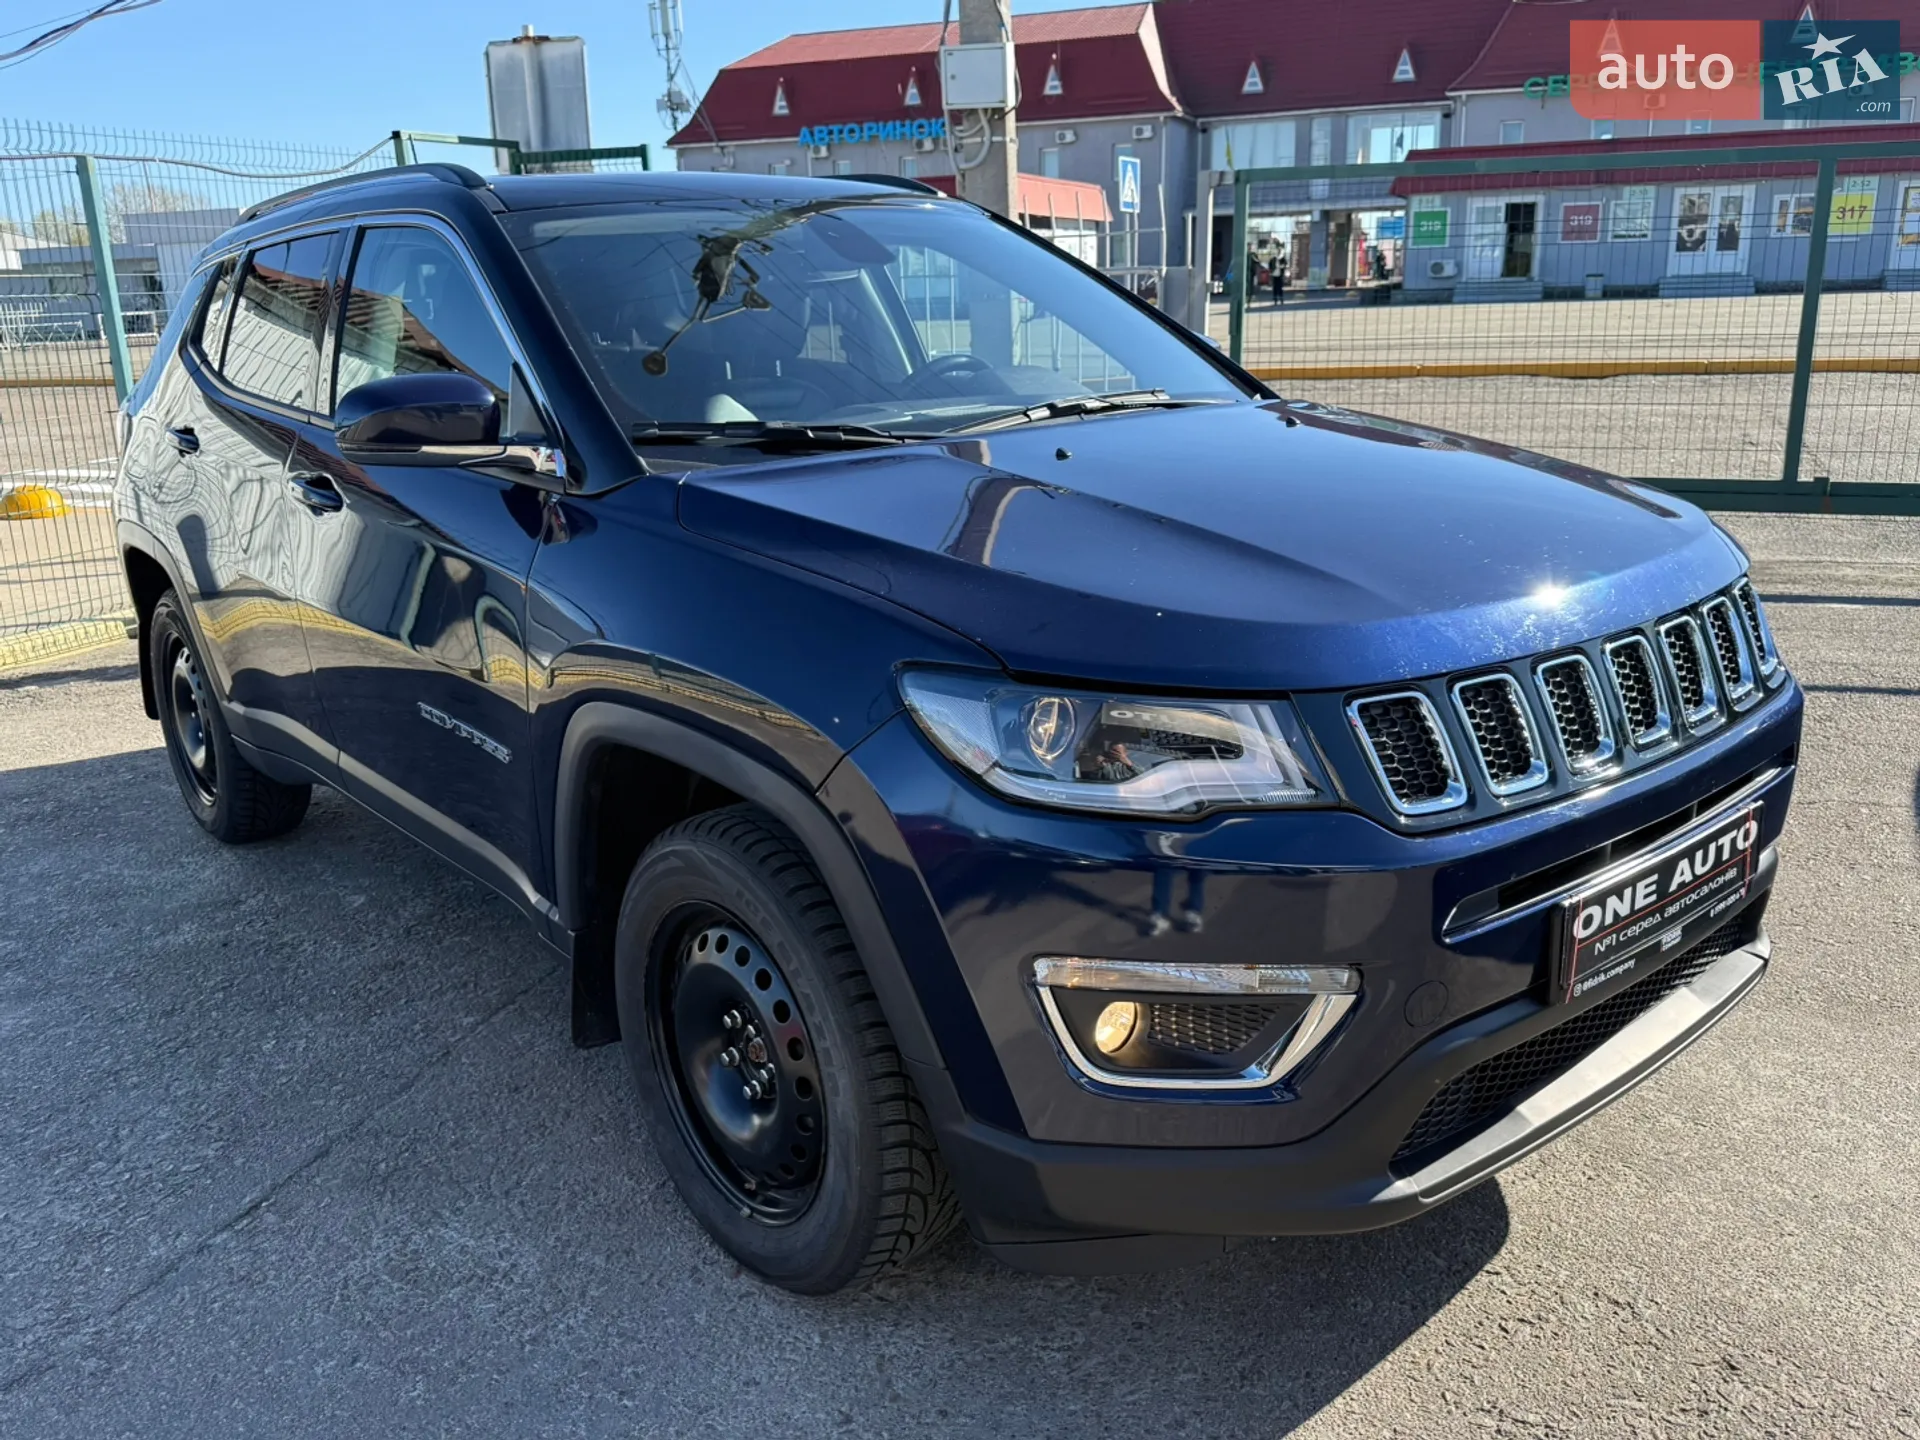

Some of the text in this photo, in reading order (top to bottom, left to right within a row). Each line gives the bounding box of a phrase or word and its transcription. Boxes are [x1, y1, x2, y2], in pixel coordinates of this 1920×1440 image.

[799, 118, 947, 146] АВТОРИНОК
[1836, 205, 1867, 220] 317
[1573, 873, 1659, 939] ONE
[1668, 820, 1758, 894] AUTO
